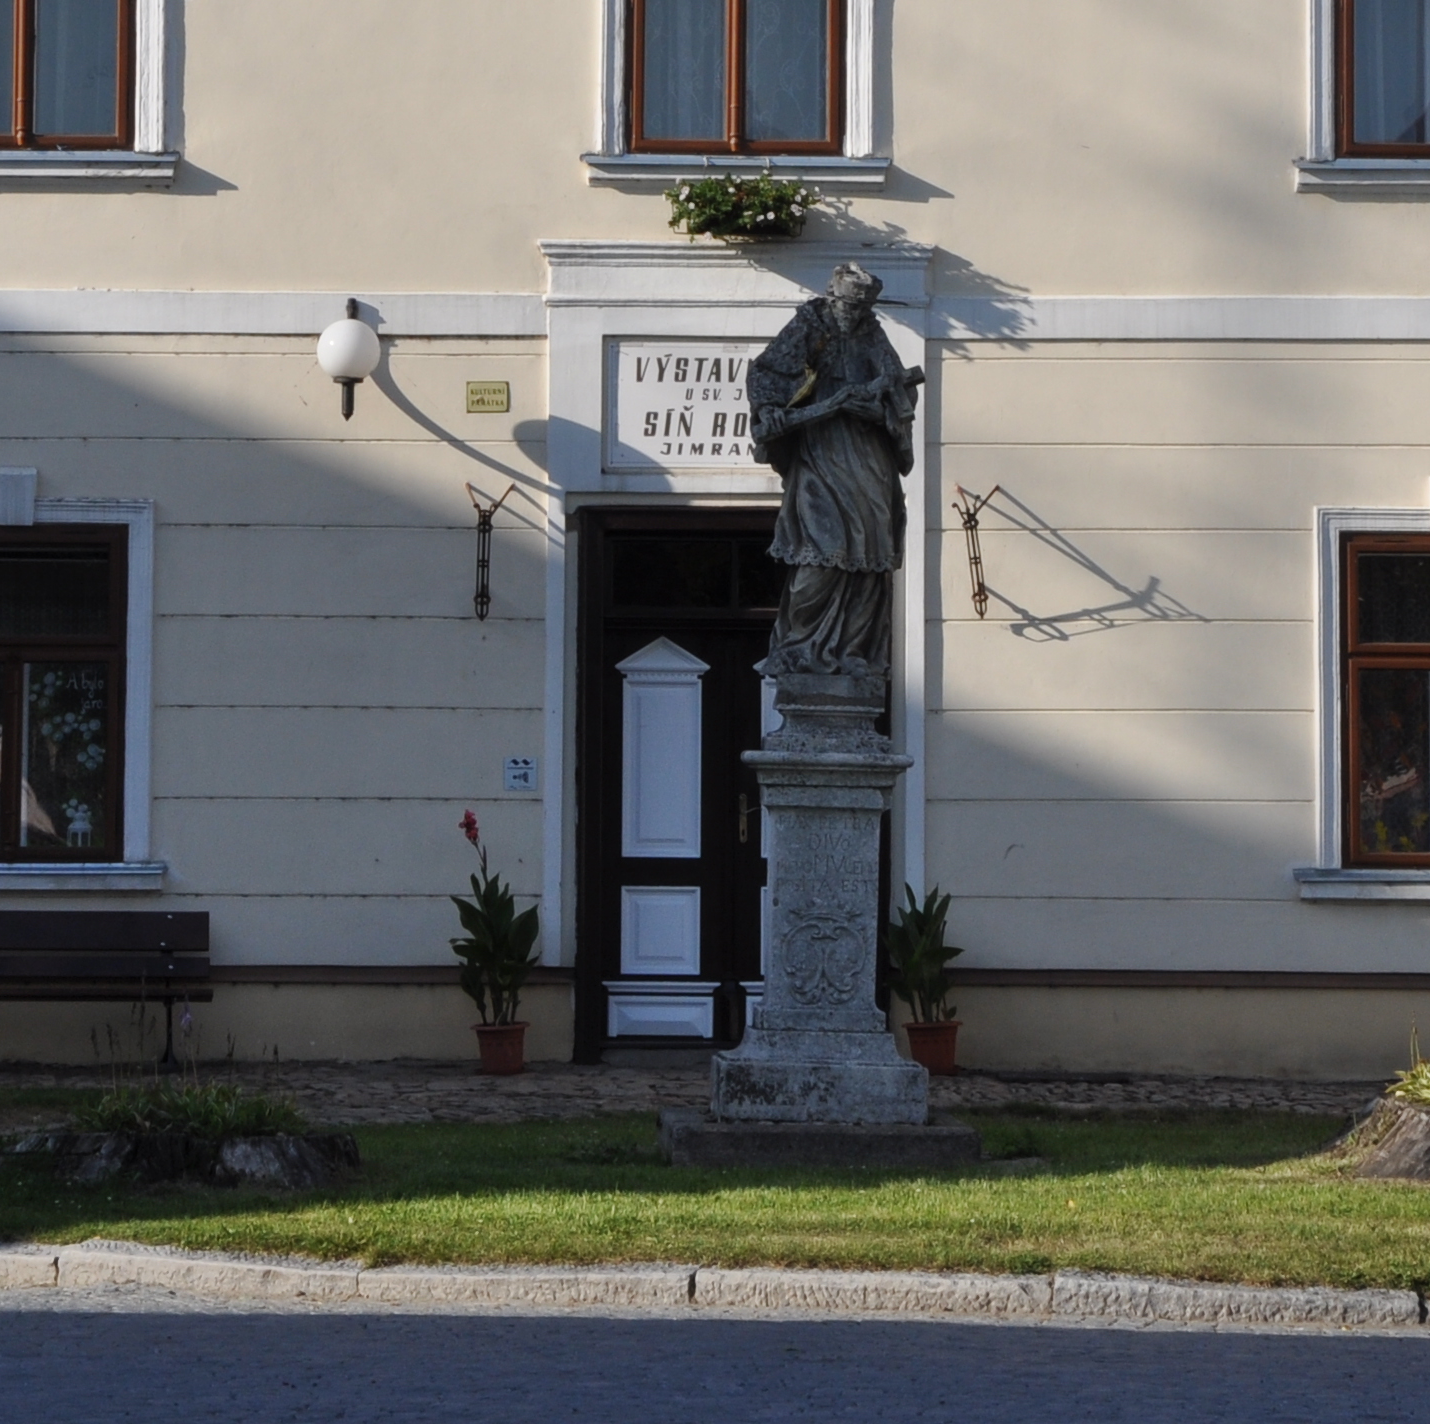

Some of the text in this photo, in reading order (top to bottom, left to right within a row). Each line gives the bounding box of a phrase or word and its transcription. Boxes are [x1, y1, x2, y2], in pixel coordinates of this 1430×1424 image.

[635, 353, 754, 384] VÝSTAV
[470, 386, 506, 395] KULTURNÍ
[685, 388, 694, 401] U
[702, 388, 722, 402] SV.
[643, 404, 752, 439] SÍŇ RO
[65, 671, 104, 699] A bylo
